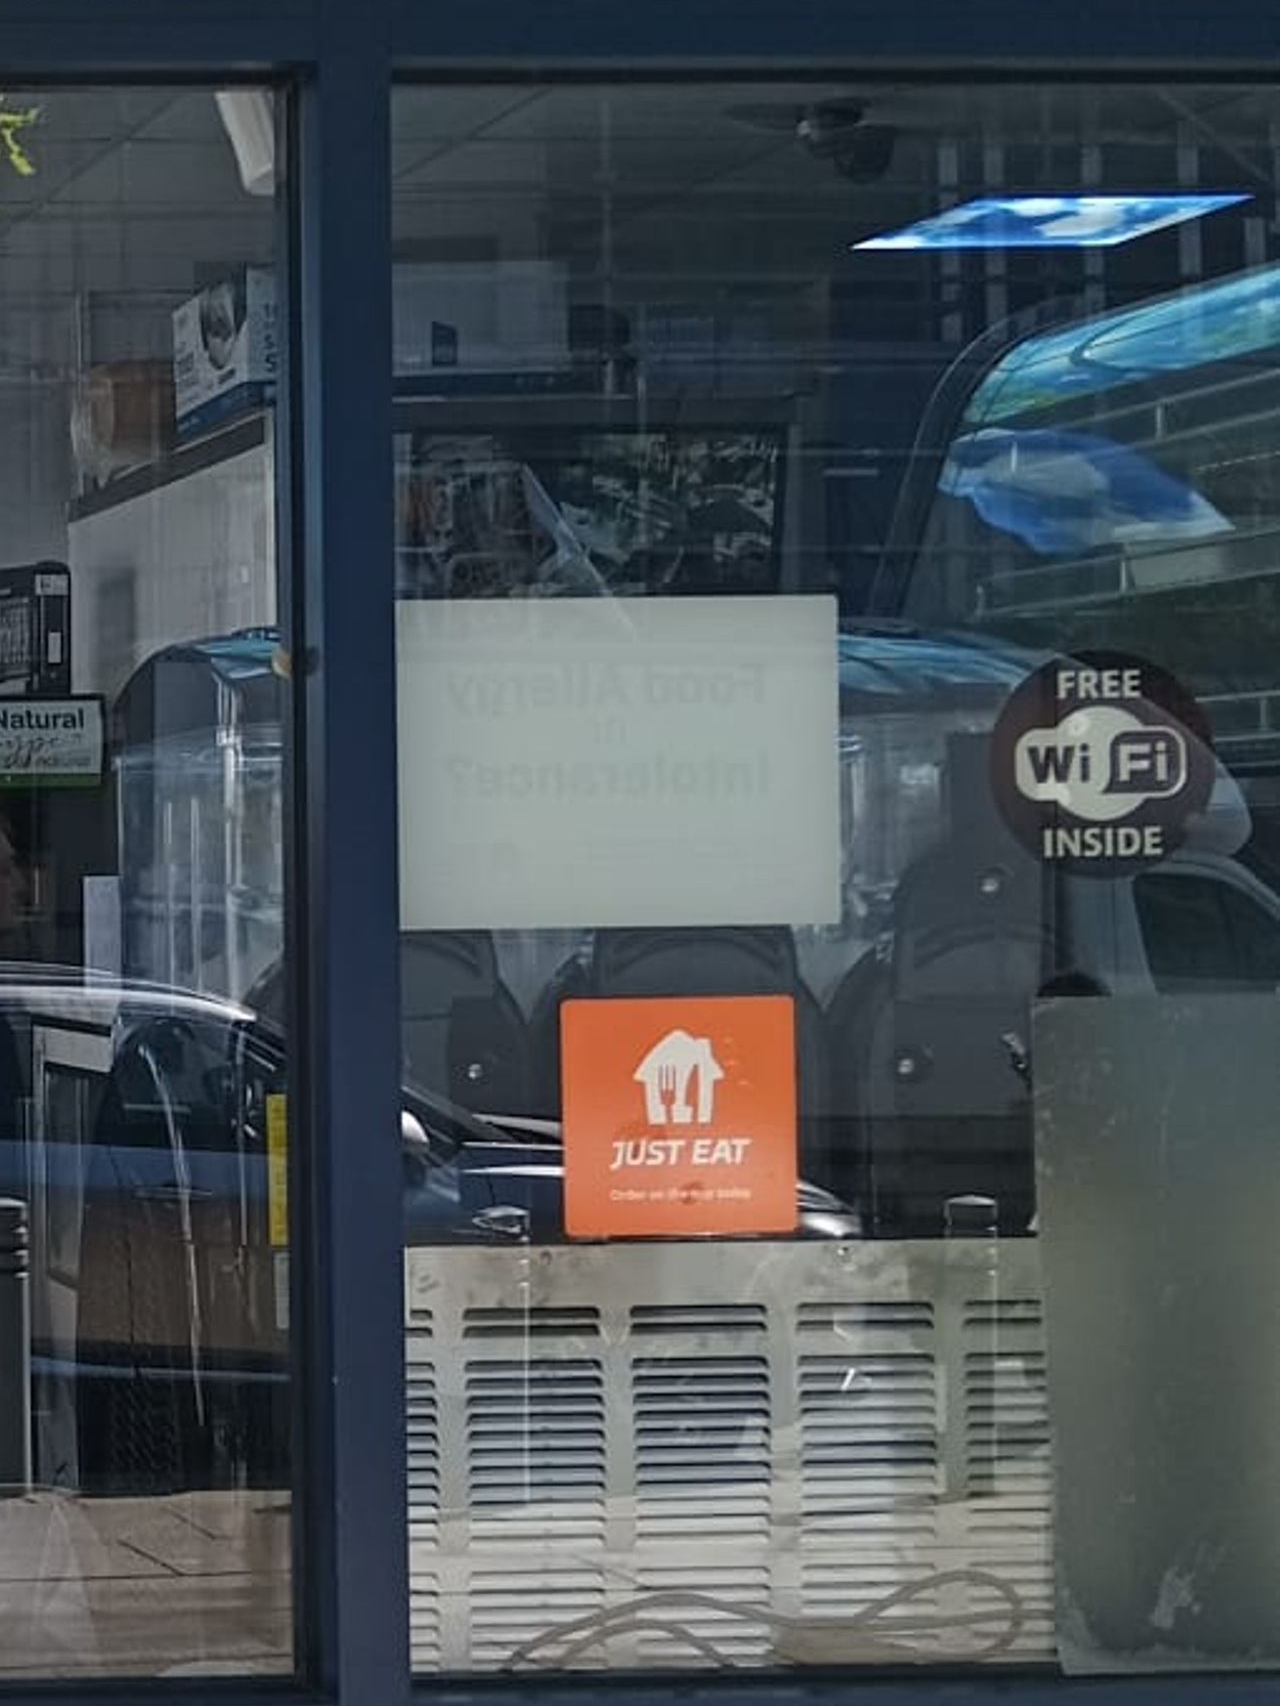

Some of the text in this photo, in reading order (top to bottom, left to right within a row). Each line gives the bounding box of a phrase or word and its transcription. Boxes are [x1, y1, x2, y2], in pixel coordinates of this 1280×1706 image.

[1056, 669, 1142, 699] FREE
[1042, 826, 1164, 859] INSIDE
[609, 1138, 752, 1171] JUST EAT
